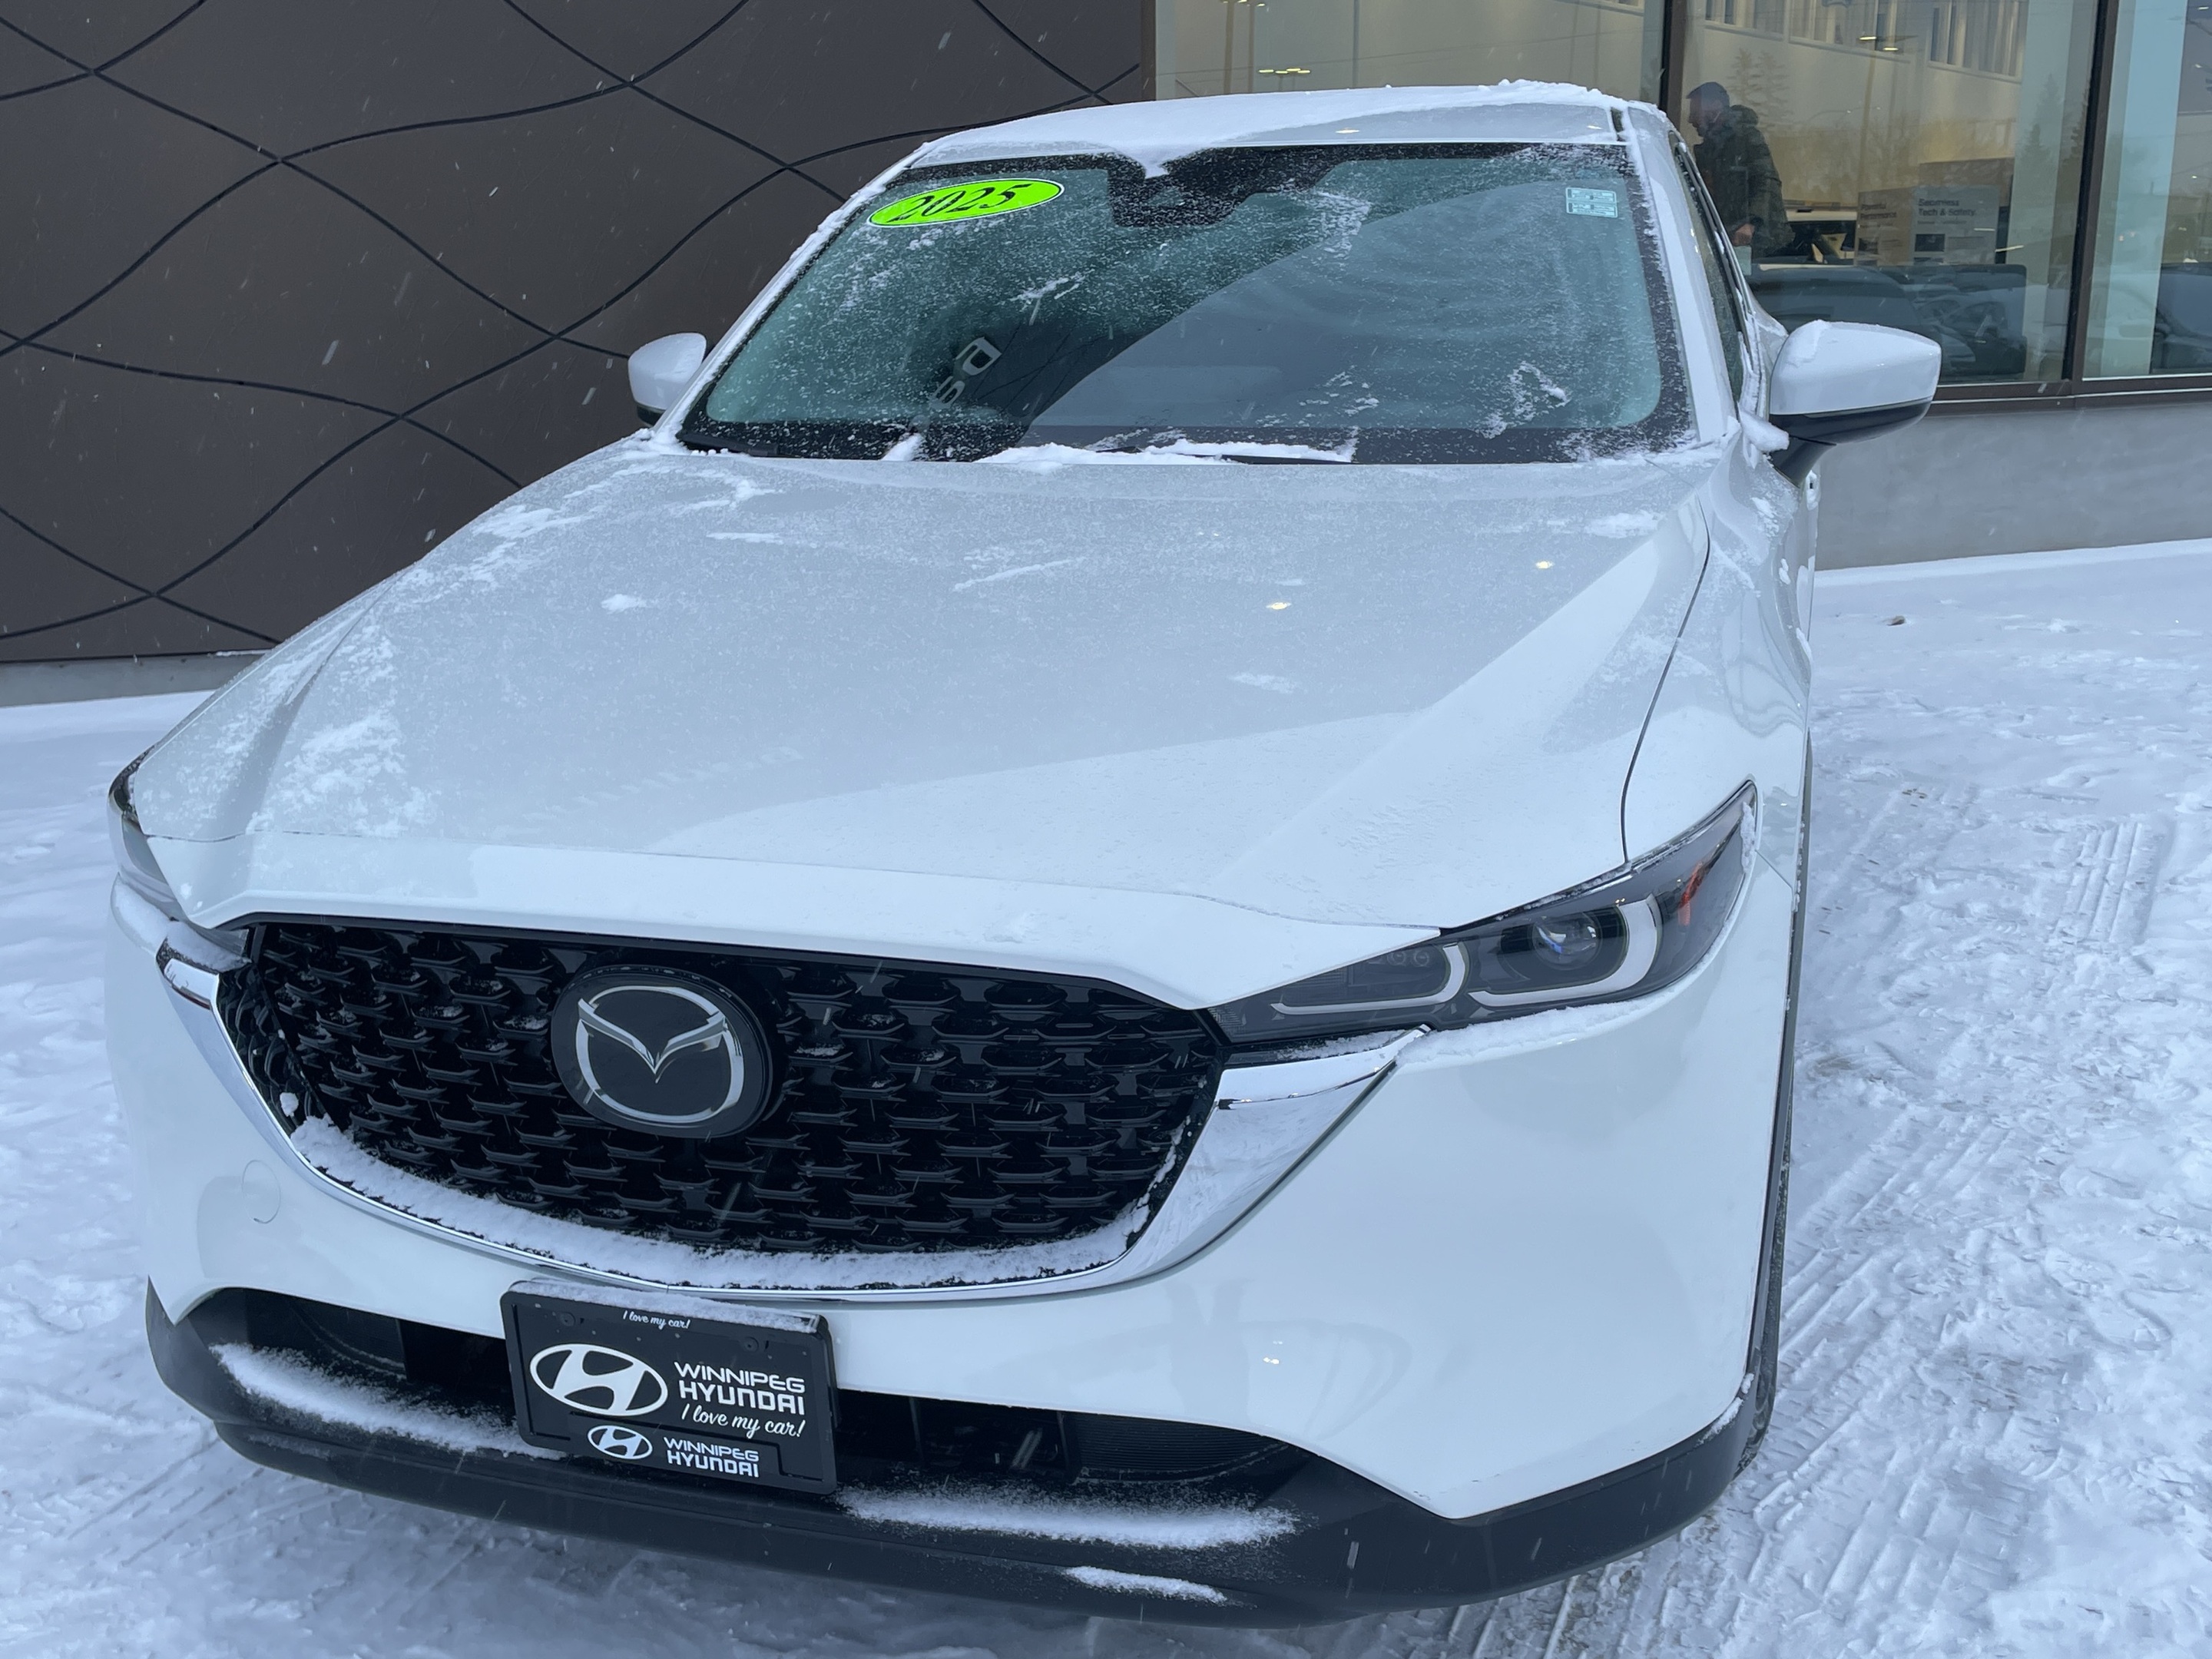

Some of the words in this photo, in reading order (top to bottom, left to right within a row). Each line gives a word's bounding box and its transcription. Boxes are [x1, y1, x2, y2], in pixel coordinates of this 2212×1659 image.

[886, 183, 1032, 223] 2025
[623, 1310, 628, 1320] I
[629, 1311, 649, 1323] love
[651, 1316, 667, 1330] my
[668, 1319, 690, 1329] car!
[674, 1361, 805, 1393] WINNIPEG
[679, 1380, 805, 1415] HYUNDAI
[681, 1403, 690, 1419] I
[693, 1405, 728, 1426] love
[731, 1416, 760, 1439] my
[764, 1419, 806, 1437] car!
[664, 1437, 760, 1462] WINNIPEG
[667, 1450, 759, 1478] HYUNDAI
